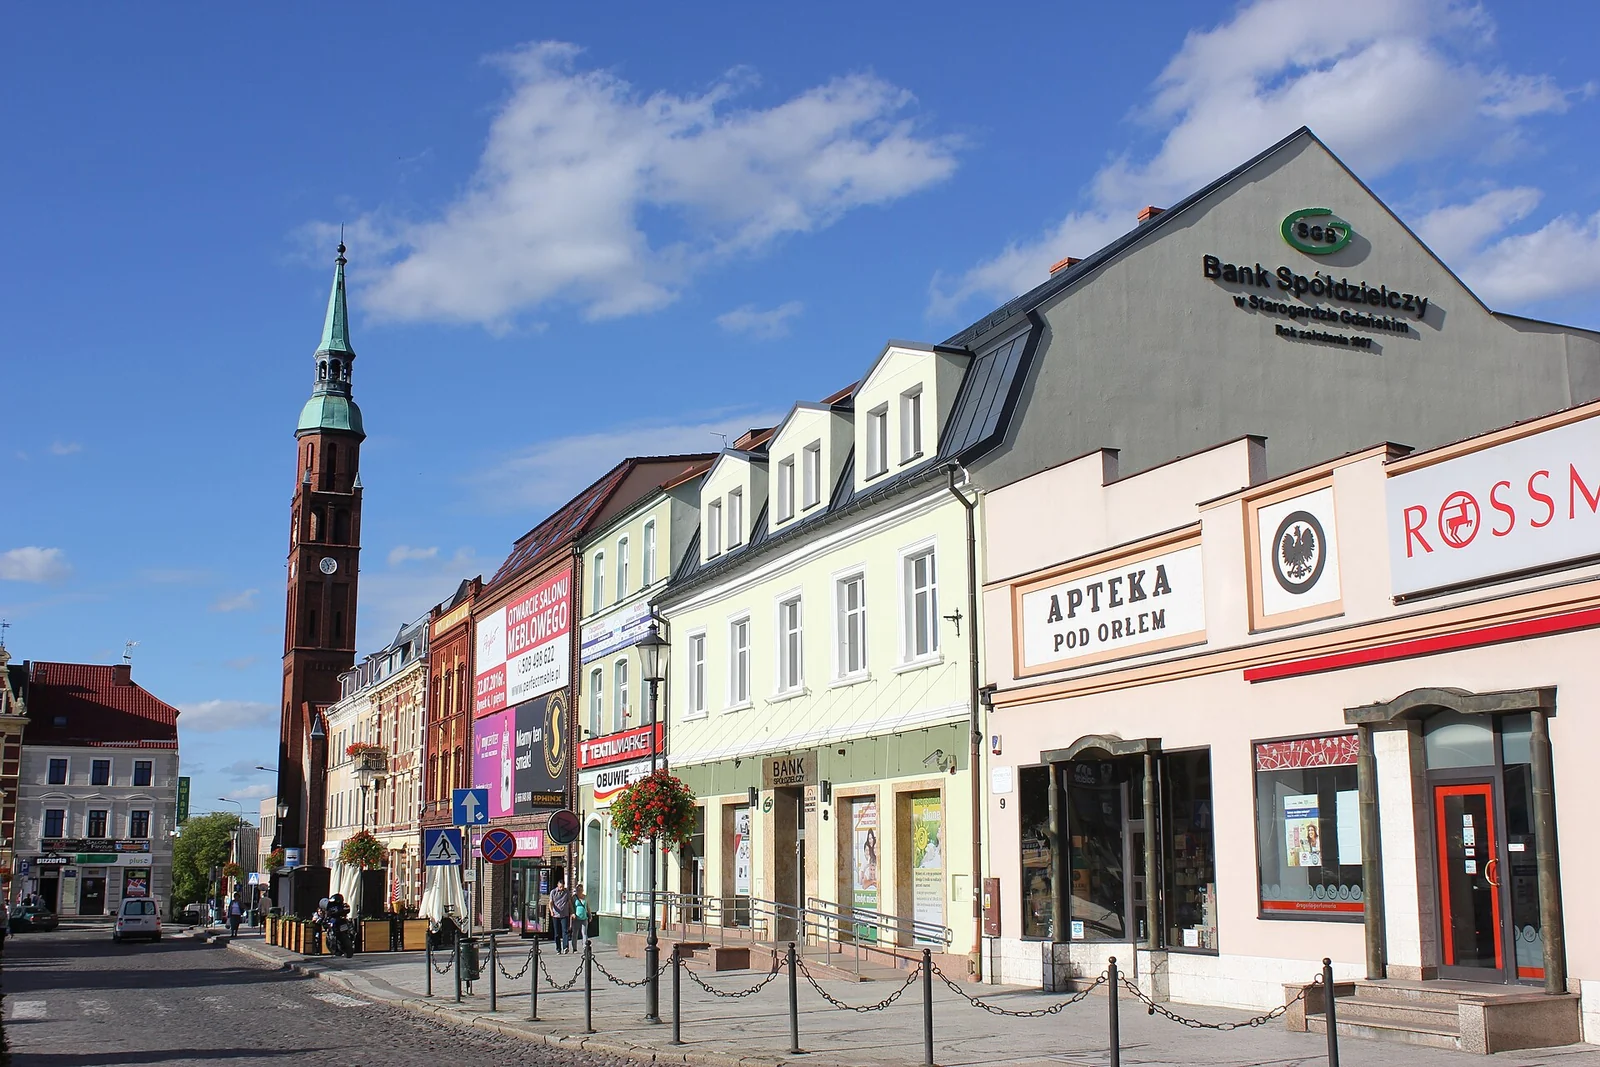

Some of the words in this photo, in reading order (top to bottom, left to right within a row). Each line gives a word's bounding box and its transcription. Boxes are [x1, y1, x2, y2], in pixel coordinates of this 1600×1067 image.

[1297, 222, 1337, 244] SGB
[1202, 254, 1271, 288] Bank
[1276, 266, 1429, 319] Spółdzielczy
[1232, 295, 1246, 308] w
[1248, 294, 1339, 322] Starogardzie
[1340, 310, 1409, 333] Gdańskim
[1275, 324, 1297, 339] Rok
[1298, 329, 1349, 345] założenia
[508, 592, 539, 626] OTWARCIE
[539, 577, 568, 608] SALONU
[1047, 564, 1172, 623] APTEKA
[507, 600, 568, 655] MEBLOWEGO
[1054, 627, 1090, 652] POD
[1098, 609, 1166, 642] ORŁEM
[516, 729, 532, 748] Mamy
[533, 726, 542, 743] ten
[589, 731, 652, 760] TEXTILMARKET
[773, 757, 804, 777] BANK
[596, 769, 630, 788] OBUWIE
[533, 794, 562, 802] SPHINX
[1000, 797, 1006, 810] 9
[823, 809, 829, 821] 8
[36, 857, 67, 865] pizzeria
